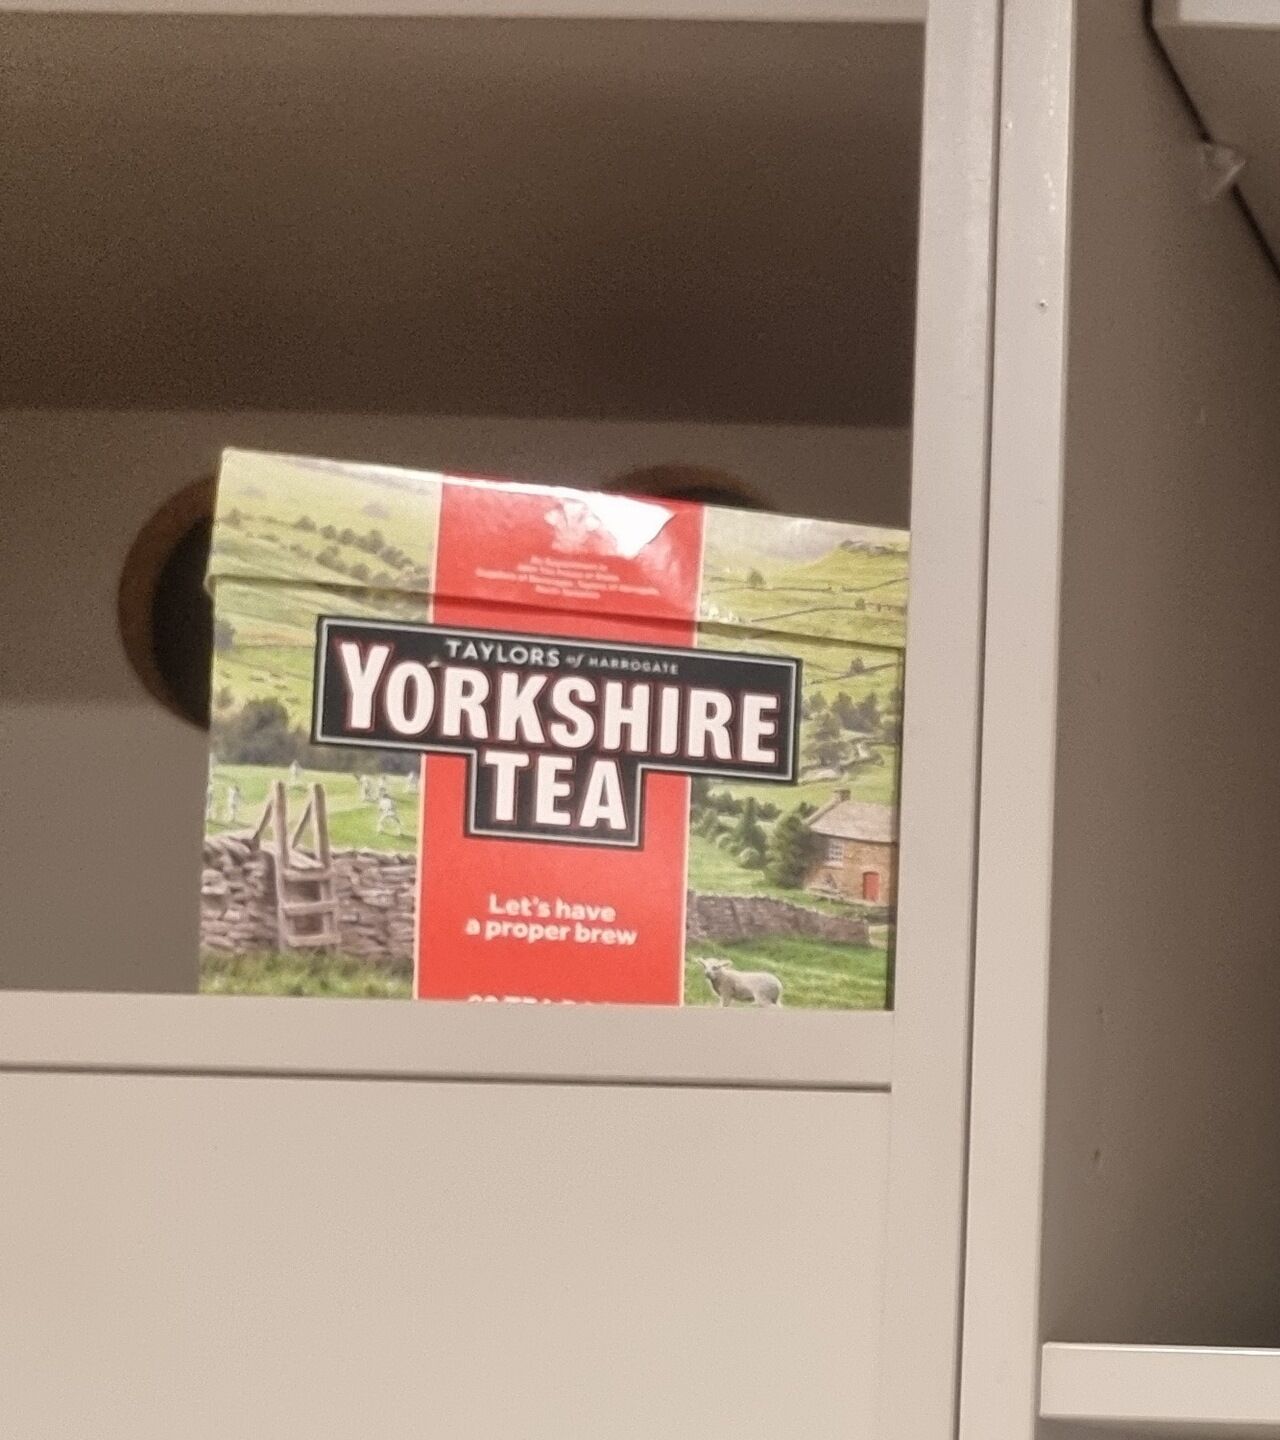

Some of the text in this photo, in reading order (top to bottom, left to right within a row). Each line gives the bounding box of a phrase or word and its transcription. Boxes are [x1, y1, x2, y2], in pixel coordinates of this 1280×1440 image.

[445, 638, 561, 668] TAYLORS
[588, 656, 680, 676] HARROGATE
[338, 641, 778, 765] YORKSHIRE
[484, 750, 628, 831] TEA
[488, 892, 617, 923] Let's have
[465, 917, 638, 946] a proper brew
